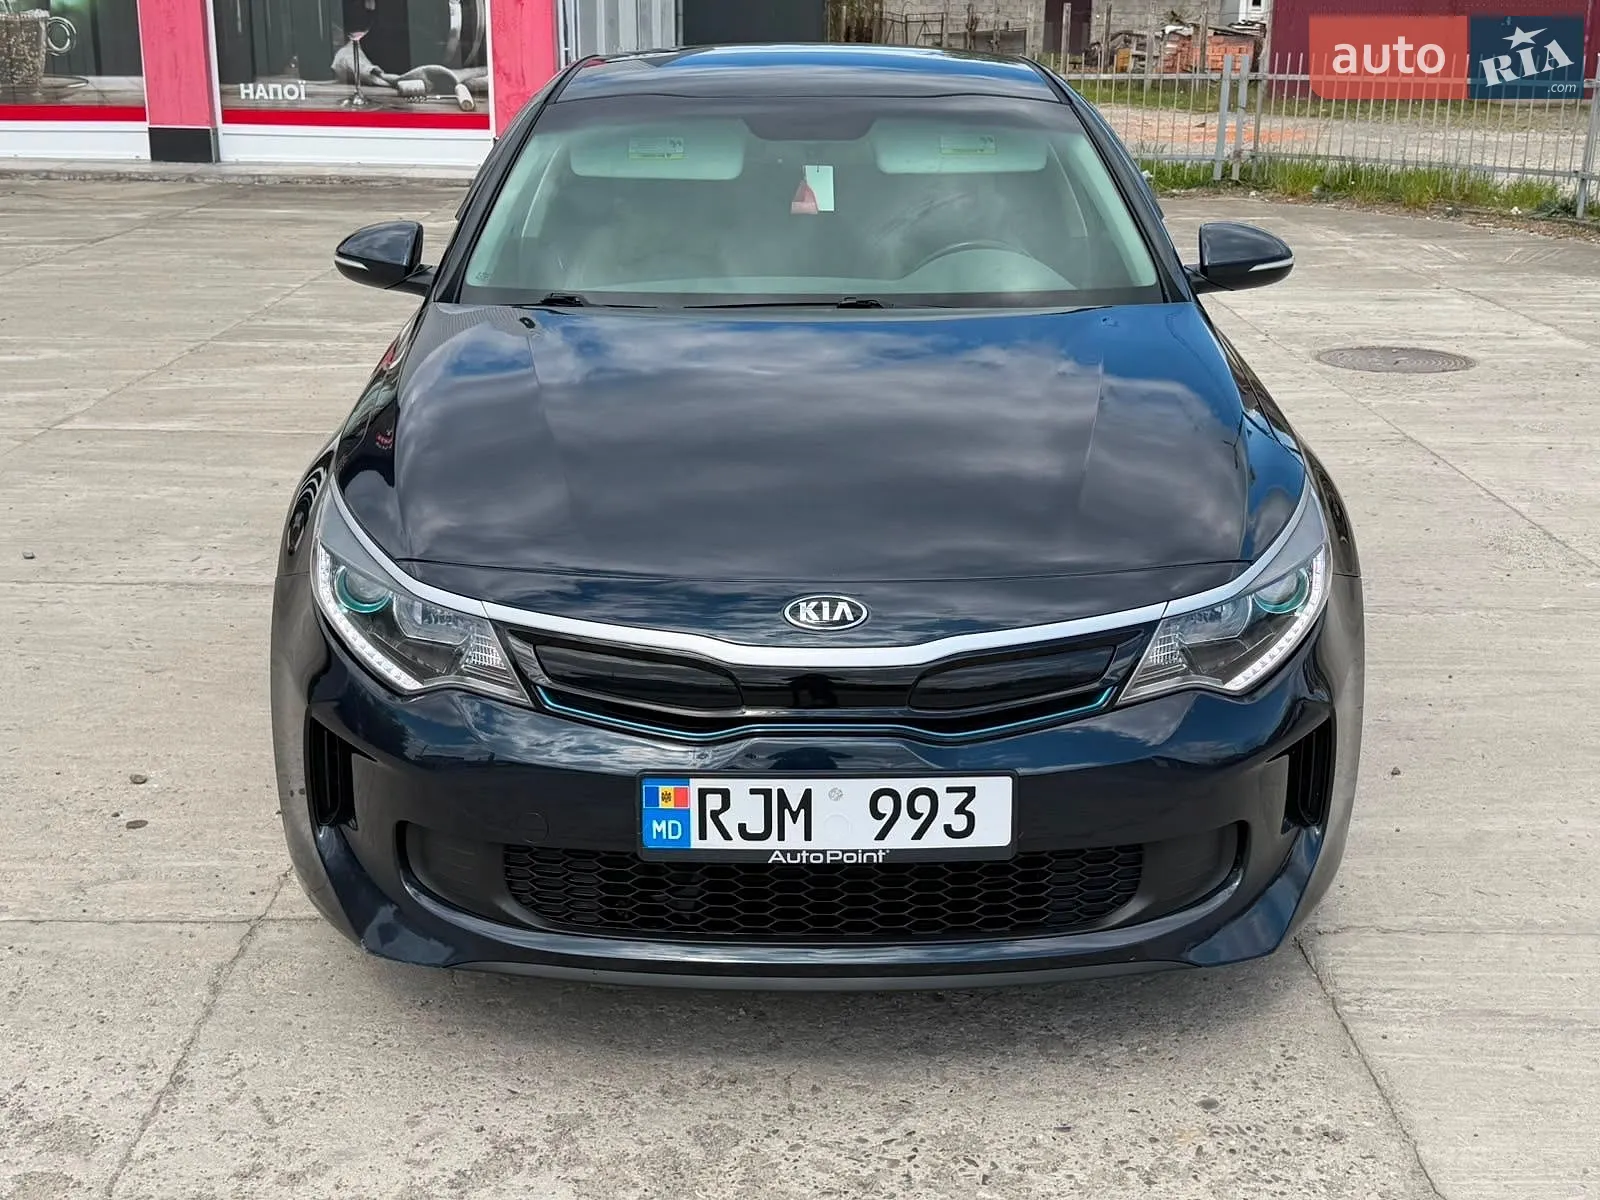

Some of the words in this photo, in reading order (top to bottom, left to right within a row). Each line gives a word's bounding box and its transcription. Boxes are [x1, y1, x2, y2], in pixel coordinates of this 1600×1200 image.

[240, 80, 306, 100] НАПОЇ
[799, 601, 854, 621] KIA
[697, 787, 813, 842] RJM
[869, 786, 977, 841] 993
[652, 820, 682, 840] MD
